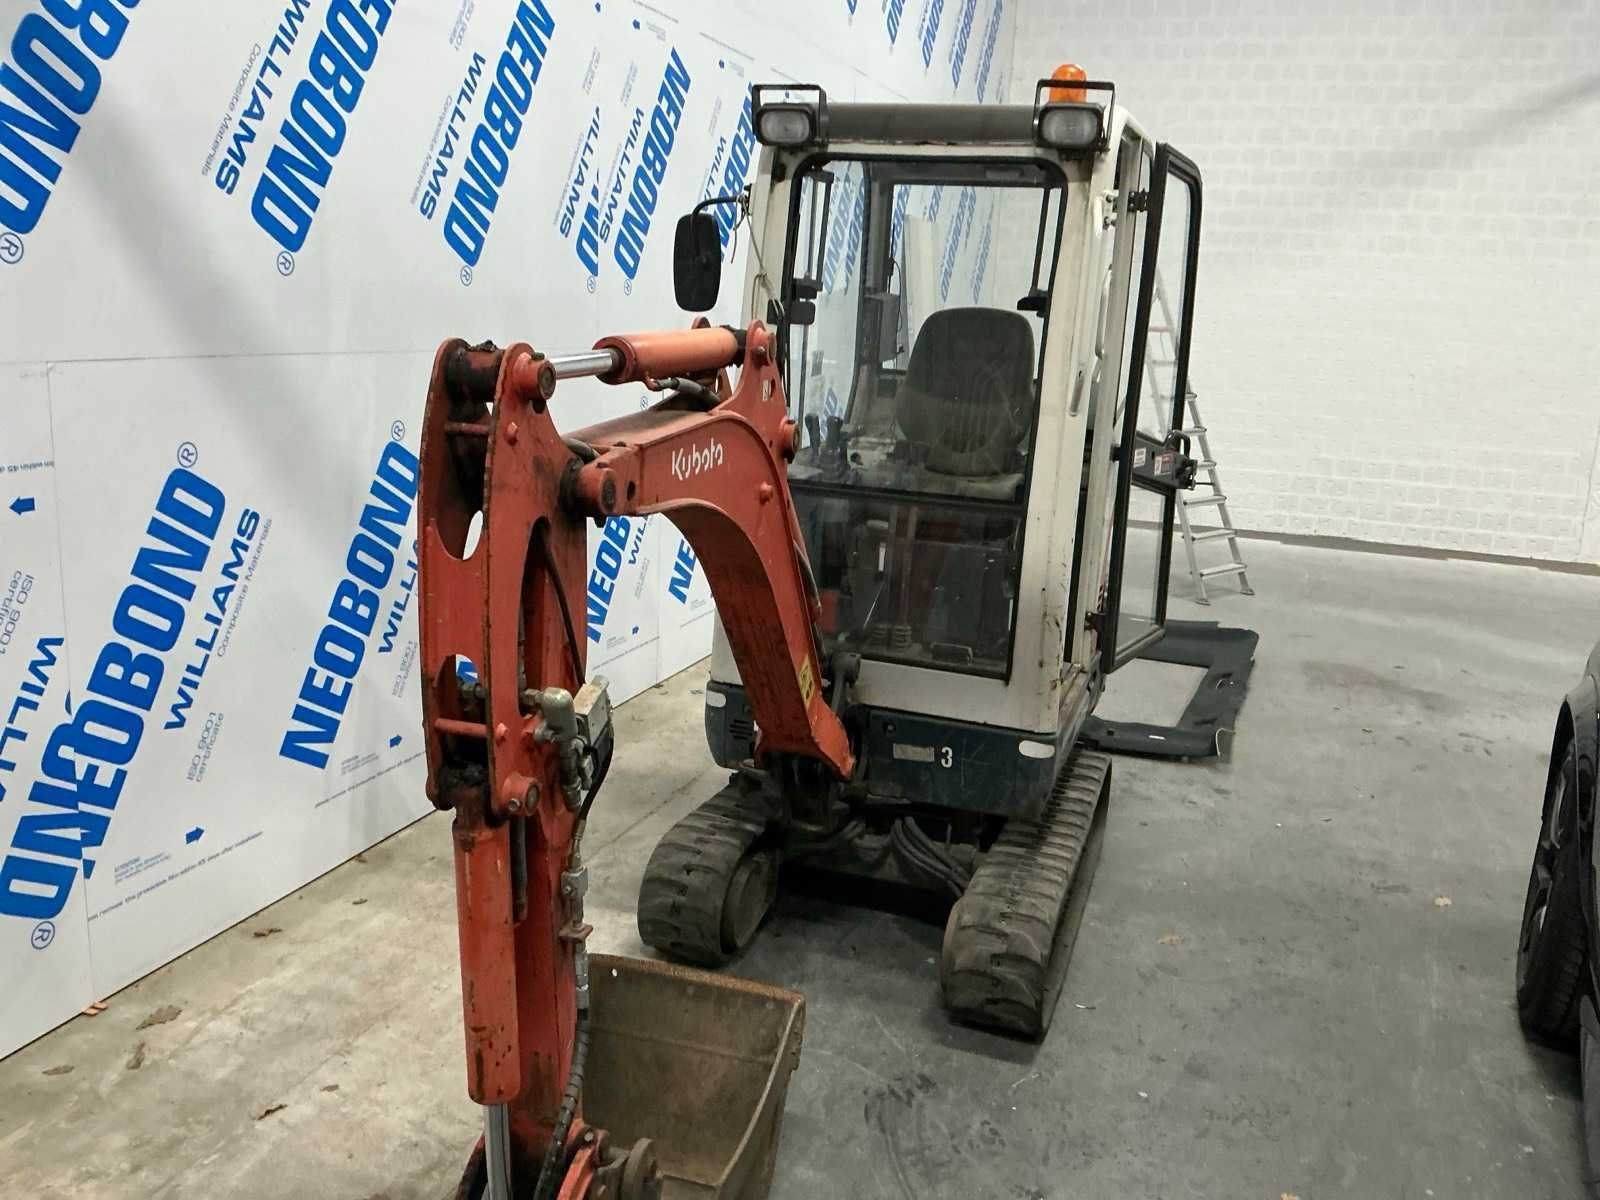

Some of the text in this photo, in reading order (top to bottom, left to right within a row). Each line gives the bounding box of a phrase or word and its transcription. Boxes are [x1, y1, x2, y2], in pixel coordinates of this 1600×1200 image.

[214, 0, 311, 196] WILLIAMS
[419, 52, 486, 221] WILLIAMS
[599, 107, 645, 244] WILLIAMS
[671, 437, 724, 481] Kubota
[163, 507, 261, 730] WILLIAMS
[197, 711, 217, 747] 9001
[940, 746, 953, 769] 3
